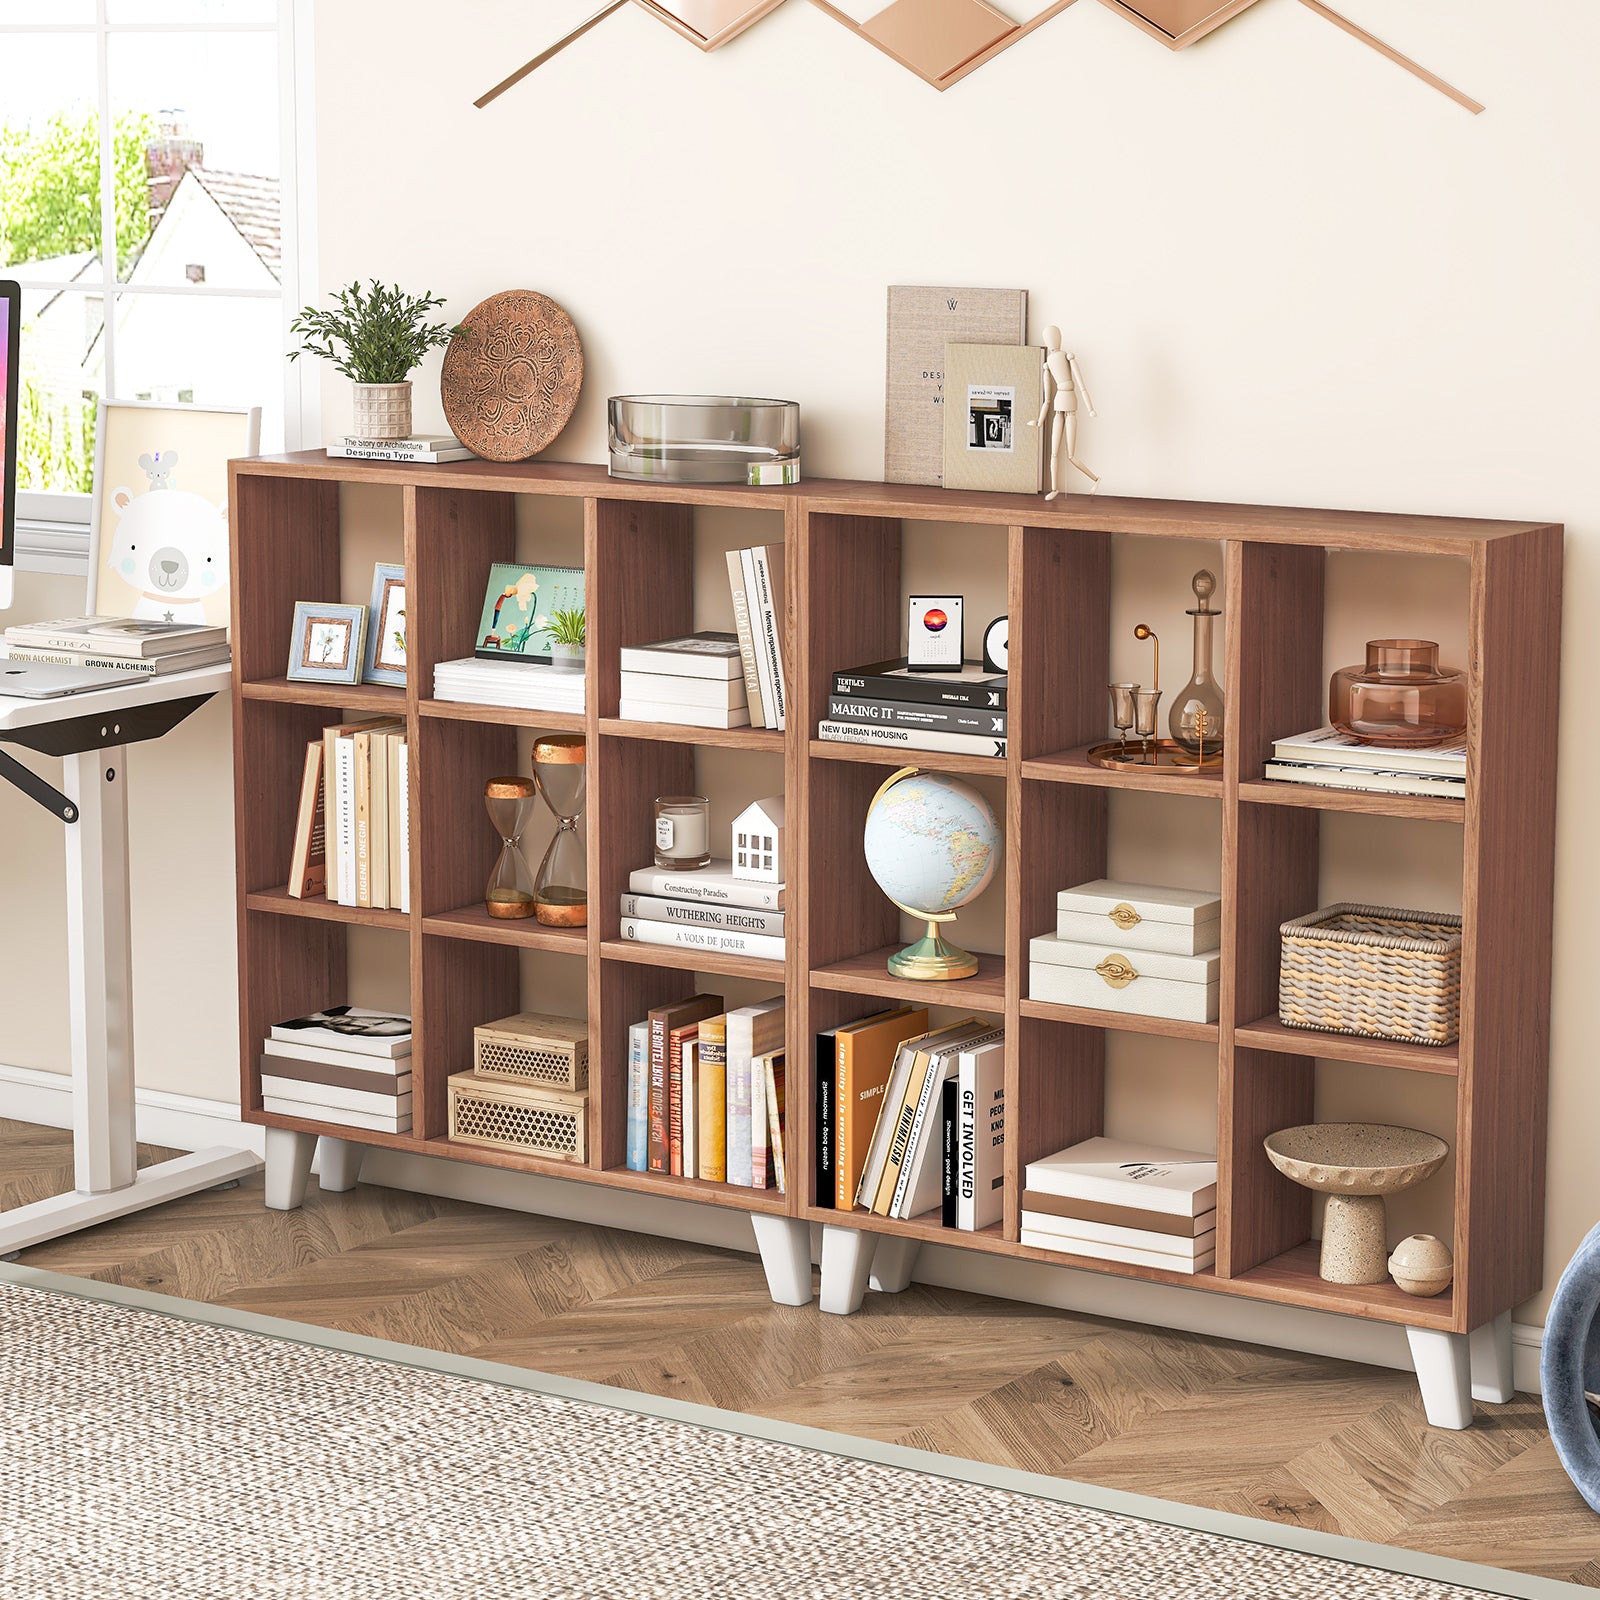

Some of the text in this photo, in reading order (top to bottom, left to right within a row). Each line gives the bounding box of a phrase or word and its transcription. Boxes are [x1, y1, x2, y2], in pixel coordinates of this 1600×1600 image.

[344, 438, 357, 446] The
[358, 439, 376, 449] Story
[384, 441, 424, 450] Architecture
[346, 448, 414, 460] Designing Type
[765, 610, 773, 634] Метод
[734, 590, 758, 693] СПАСИТЕ КОТИКА!
[32, 654, 72, 665] ALCHEMIST
[85, 659, 157, 673] GROWN ALCHEMIS
[837, 678, 864, 687] TEXTILES
[832, 702, 878, 718] MAKING
[881, 707, 894, 720] IT
[822, 724, 908, 740] NEW URBAN HOUSING
[358, 820, 366, 859] ONEGIN
[664, 882, 702, 898] Constructing
[666, 906, 766, 930] WUTHERING HEIGHTS
[676, 932, 746, 950] A VOUS DE JOUER
[860, 1084, 884, 1101] SIMPLE
[920, 1064, 934, 1108] simplicity
[840, 1092, 846, 1102] is
[840, 1104, 846, 1113] in
[890, 1104, 914, 1166] MINIMALISM
[962, 1090, 974, 1199] GET INVOLVED
[902, 1131, 917, 1177] everything
[840, 1169, 845, 1182] we
